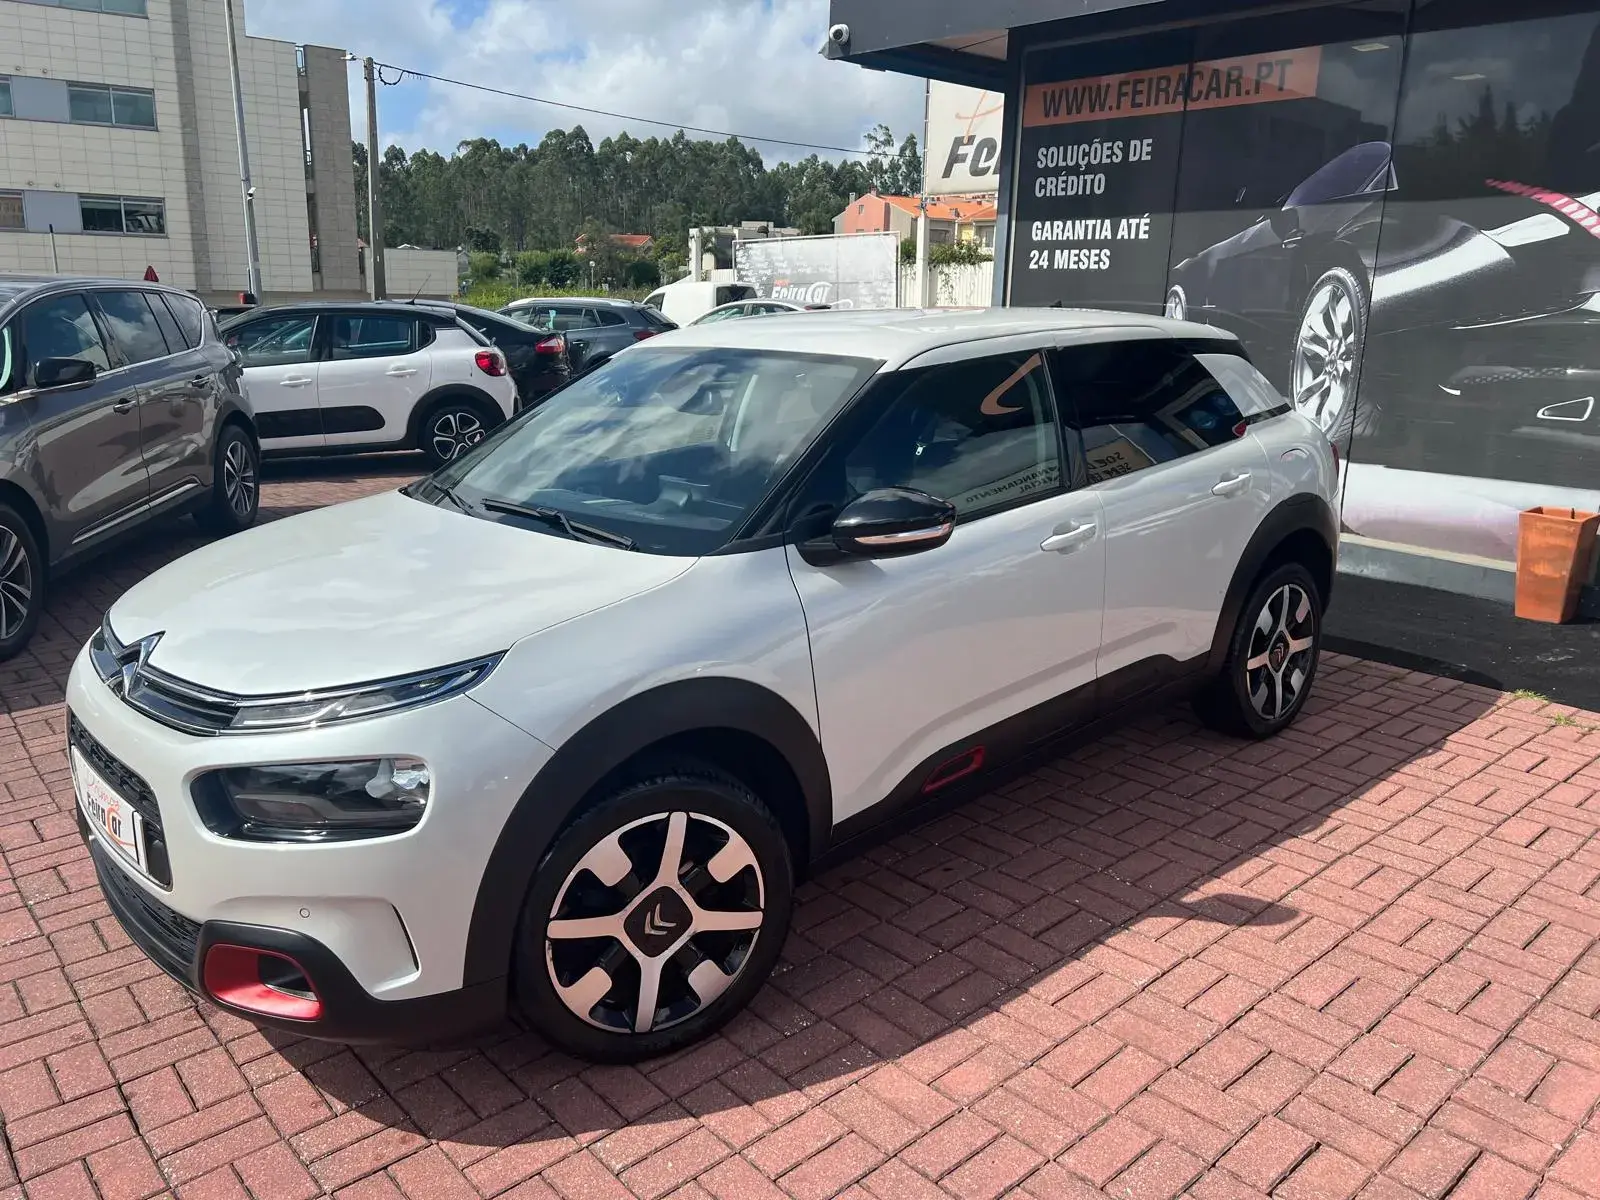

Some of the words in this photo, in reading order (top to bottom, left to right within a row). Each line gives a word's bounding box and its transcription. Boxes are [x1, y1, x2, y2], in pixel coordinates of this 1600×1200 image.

[1043, 59, 1293, 118] WWW.FEIRACAR.PT
[1036, 138, 1124, 171] SOLUÇÕES
[1128, 138, 1153, 162] DE
[1034, 170, 1106, 198] CRÉDITO
[1031, 218, 1112, 241] GARANTIA
[1116, 212, 1151, 240] ATÉ
[1028, 249, 1049, 270] 24
[1053, 248, 1111, 270] MESES
